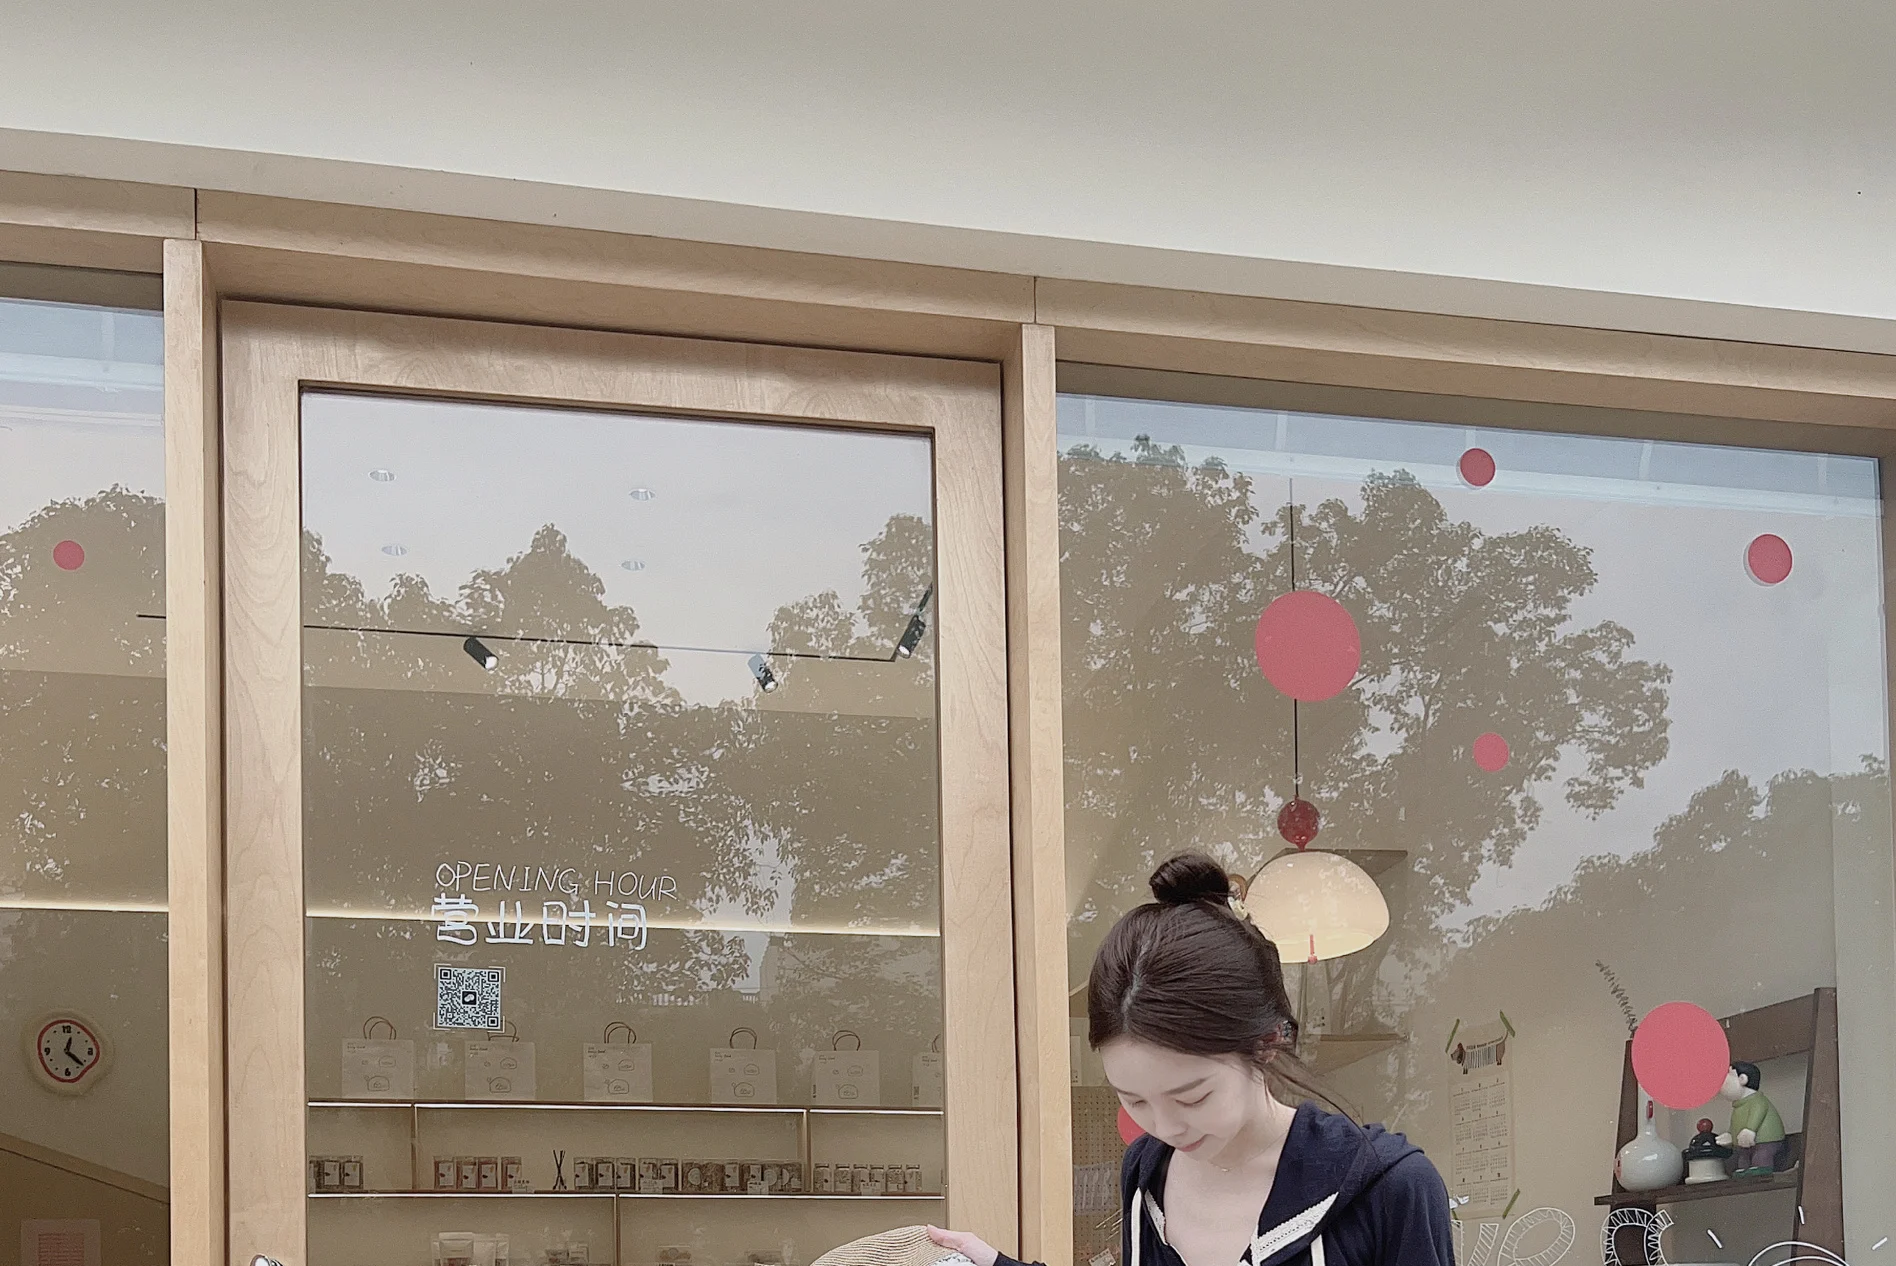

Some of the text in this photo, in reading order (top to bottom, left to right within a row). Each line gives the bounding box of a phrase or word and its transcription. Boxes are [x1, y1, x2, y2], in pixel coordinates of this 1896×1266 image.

[435, 860, 679, 901] OPENING HOUR
[431, 892, 648, 951] 营业时间
[61, 1024, 73, 1034] 12
[64, 1067, 72, 1077] 6
